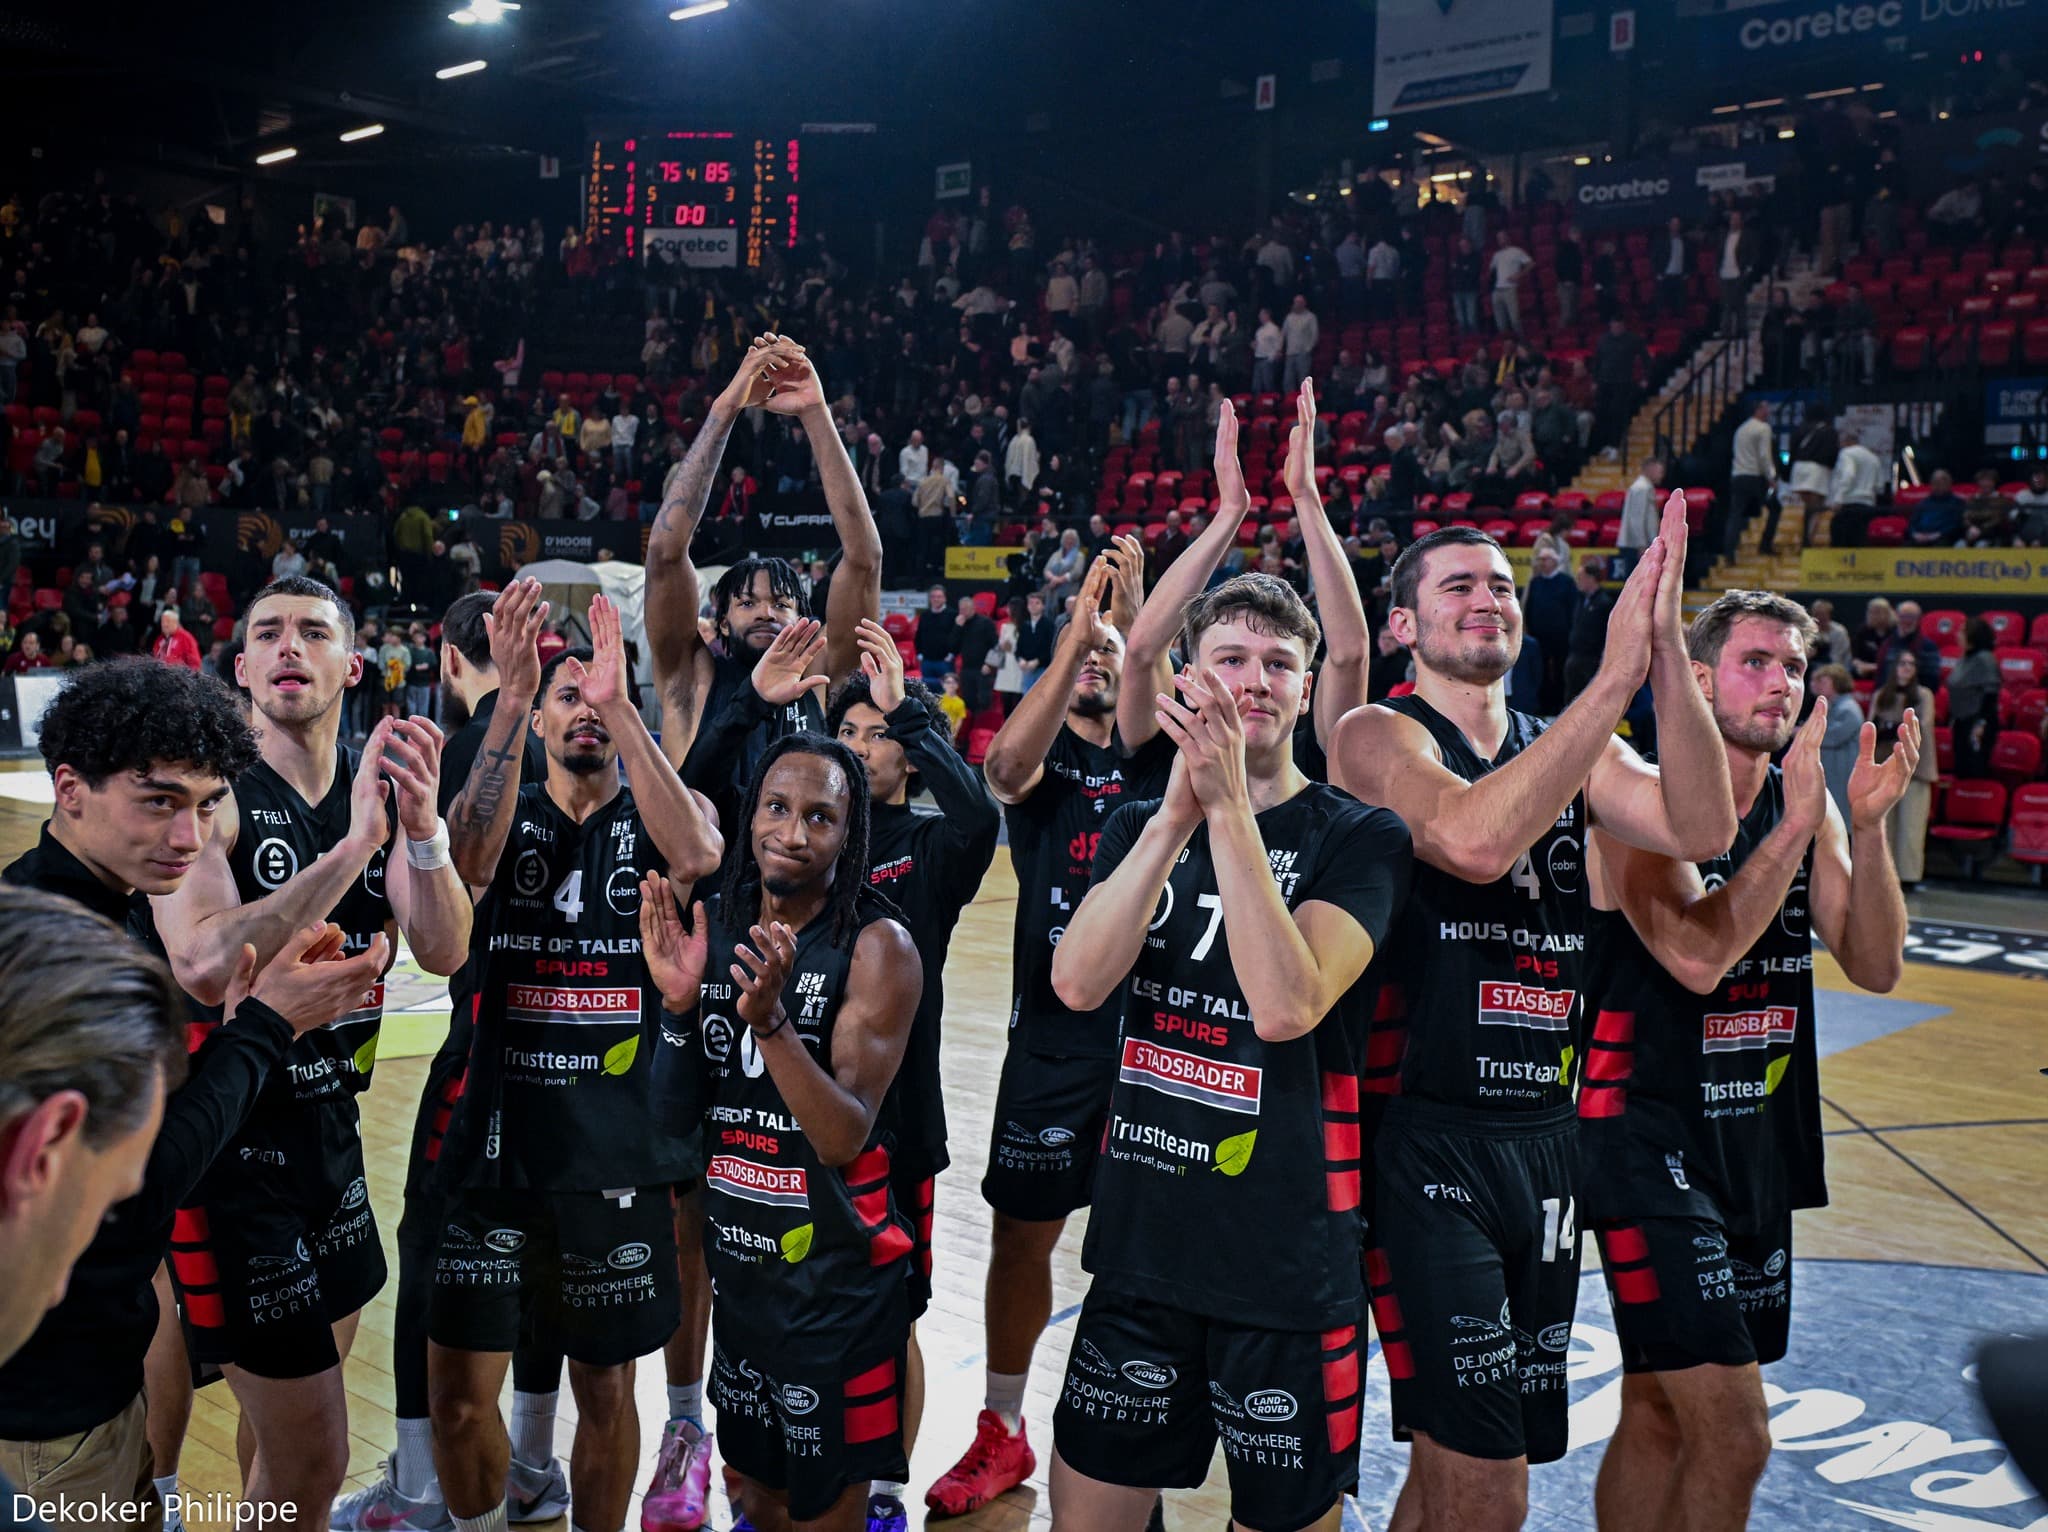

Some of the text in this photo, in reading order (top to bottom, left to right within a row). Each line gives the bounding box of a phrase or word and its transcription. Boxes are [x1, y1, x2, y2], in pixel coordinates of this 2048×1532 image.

[1615, 18, 1629, 45] B
[1740, 0, 2025, 49] Coretec DO
[1259, 82, 1272, 105] A
[660, 162, 731, 183] 75 4 85
[1578, 178, 1671, 204] Coretec
[773, 515, 833, 526] CUPRA
[1894, 559, 2032, 580] ENERGIE(ke)
[869, 860, 914, 885] SPURS
[554, 870, 584, 923] 4
[1190, 893, 1224, 961] 7
[1440, 922, 1508, 941] HOUS
[548, 936, 573, 951] OF
[536, 960, 608, 976] SPURS
[516, 989, 628, 1010] STADSBADER
[1167, 986, 1198, 1009] OF
[1153, 1011, 1230, 1047] SPURS
[504, 1047, 599, 1070] Trustteam
[1135, 1046, 1246, 1092] STADSBADER
[544, 1076, 567, 1087] pure
[1478, 1086, 1504, 1098] Pure
[720, 1129, 781, 1156] SPURS
[1112, 1114, 1210, 1162] Trustteam
[711, 1160, 803, 1191] STADSBADER
[1132, 1150, 1157, 1168] trust,
[1156, 1159, 1177, 1174] pure
[1177, 1165, 1188, 1177] IT
[561, 1273, 655, 1296] DEJONCKHEERE
[561, 1288, 657, 1309] KORTRIJK
[1073, 1356, 1118, 1380] JAGUAR
[1066, 1371, 1172, 1410] DEJONCKHEERE
[1063, 1389, 1169, 1425] KORTRIJK
